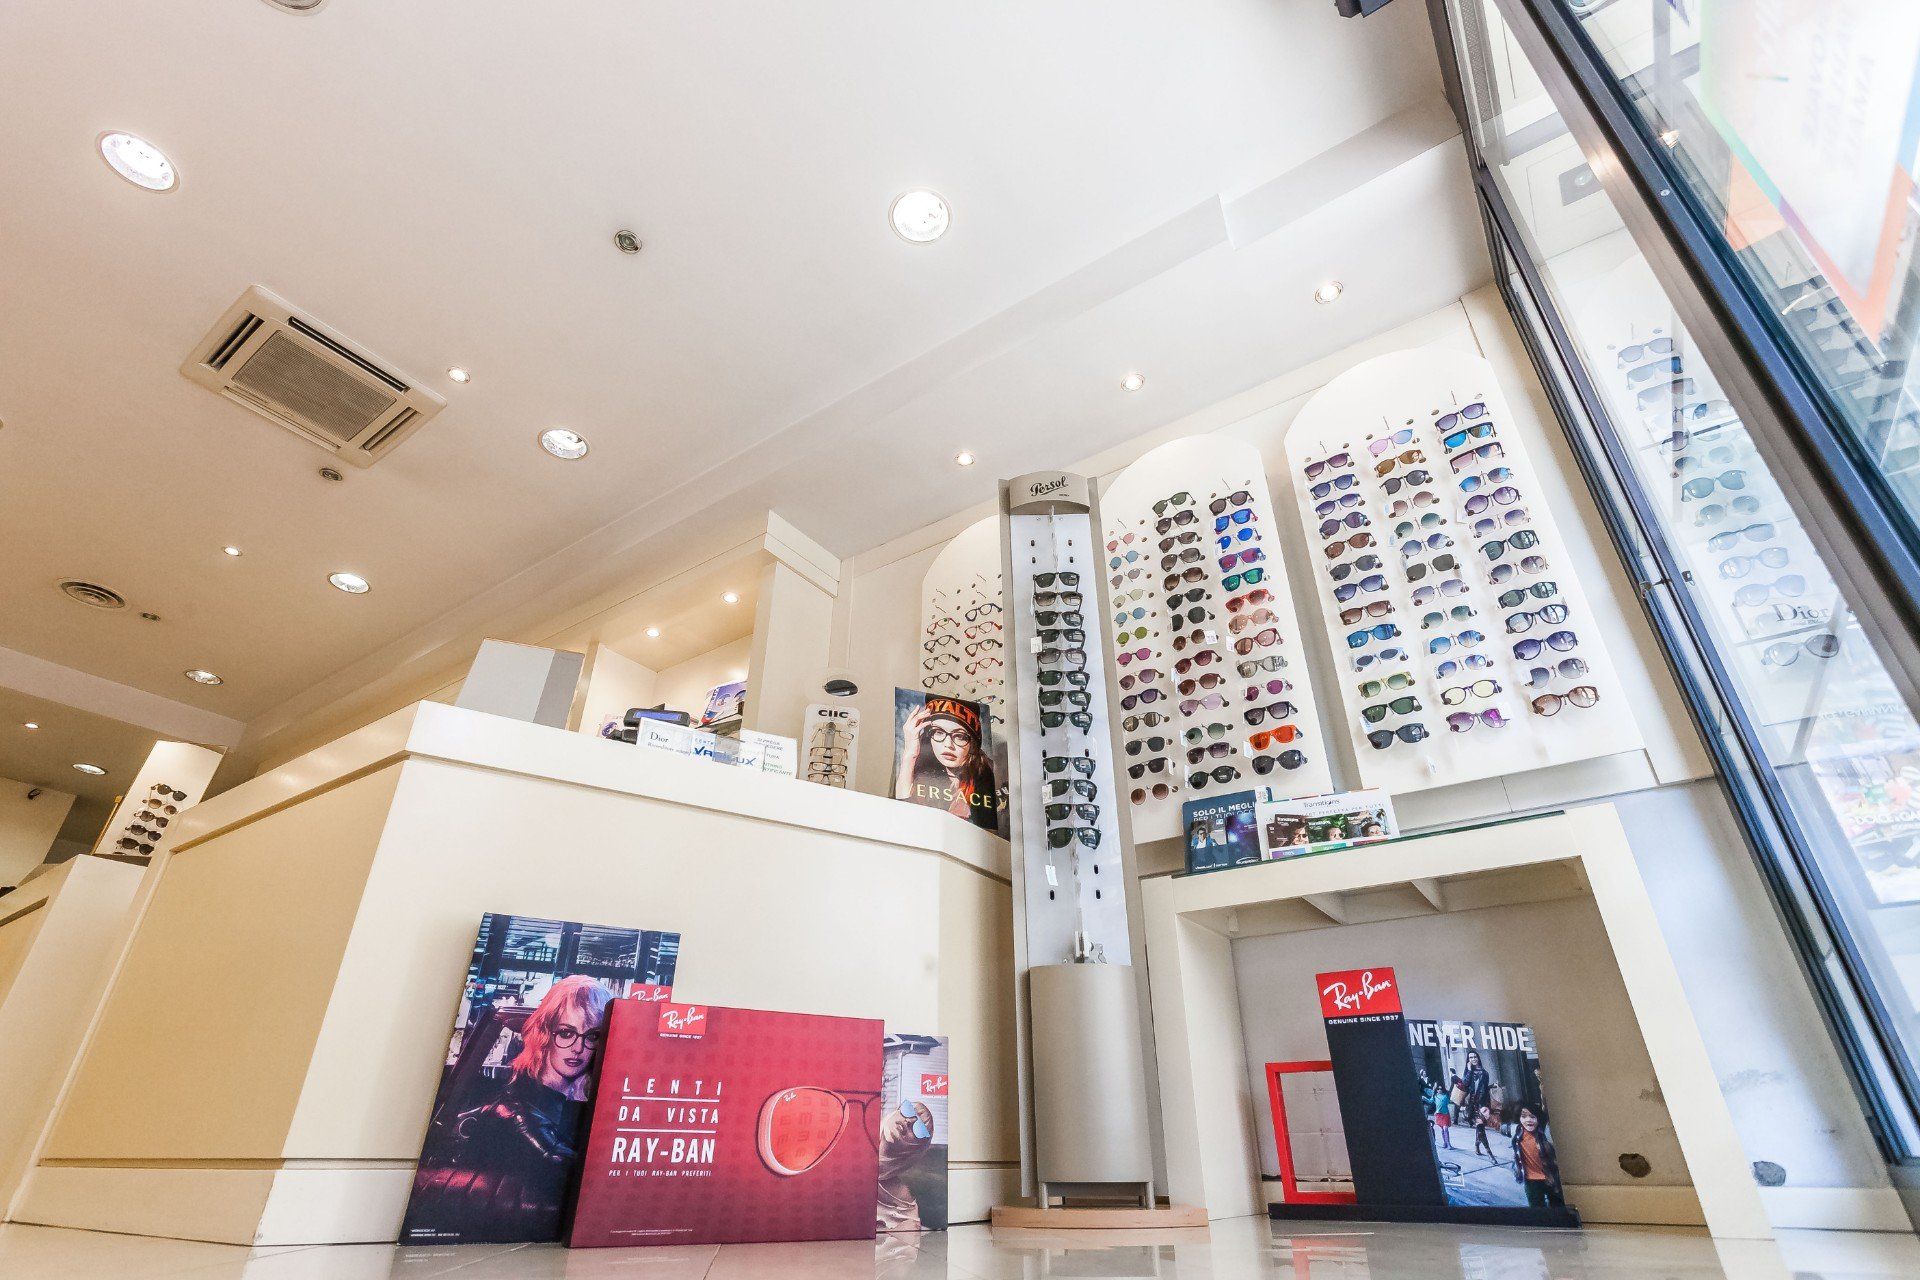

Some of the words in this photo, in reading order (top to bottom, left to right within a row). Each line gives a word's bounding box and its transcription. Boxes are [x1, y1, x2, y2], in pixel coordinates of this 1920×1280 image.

[1030, 475, 1069, 497] Persol
[1772, 602, 1832, 622] Dior
[650, 731, 669, 743] Dior
[1192, 808, 1217, 818] SOLO
[1218, 806, 1226, 814] IL
[1228, 801, 1255, 812] MEGLI
[1323, 971, 1391, 1010] Ray-Ban
[662, 1006, 705, 1030] Ray-Ban
[1328, 1017, 1358, 1025] GENUINE
[1408, 1021, 1476, 1049] NEVER
[1480, 1025, 1533, 1051] HIDE
[622, 1076, 722, 1097] LENTI
[618, 1105, 641, 1122] DA
[666, 1106, 720, 1125] VISTA
[611, 1136, 717, 1164] RAY-BAN
[608, 1169, 622, 1177] PER
[633, 1169, 649, 1177] TUOI
